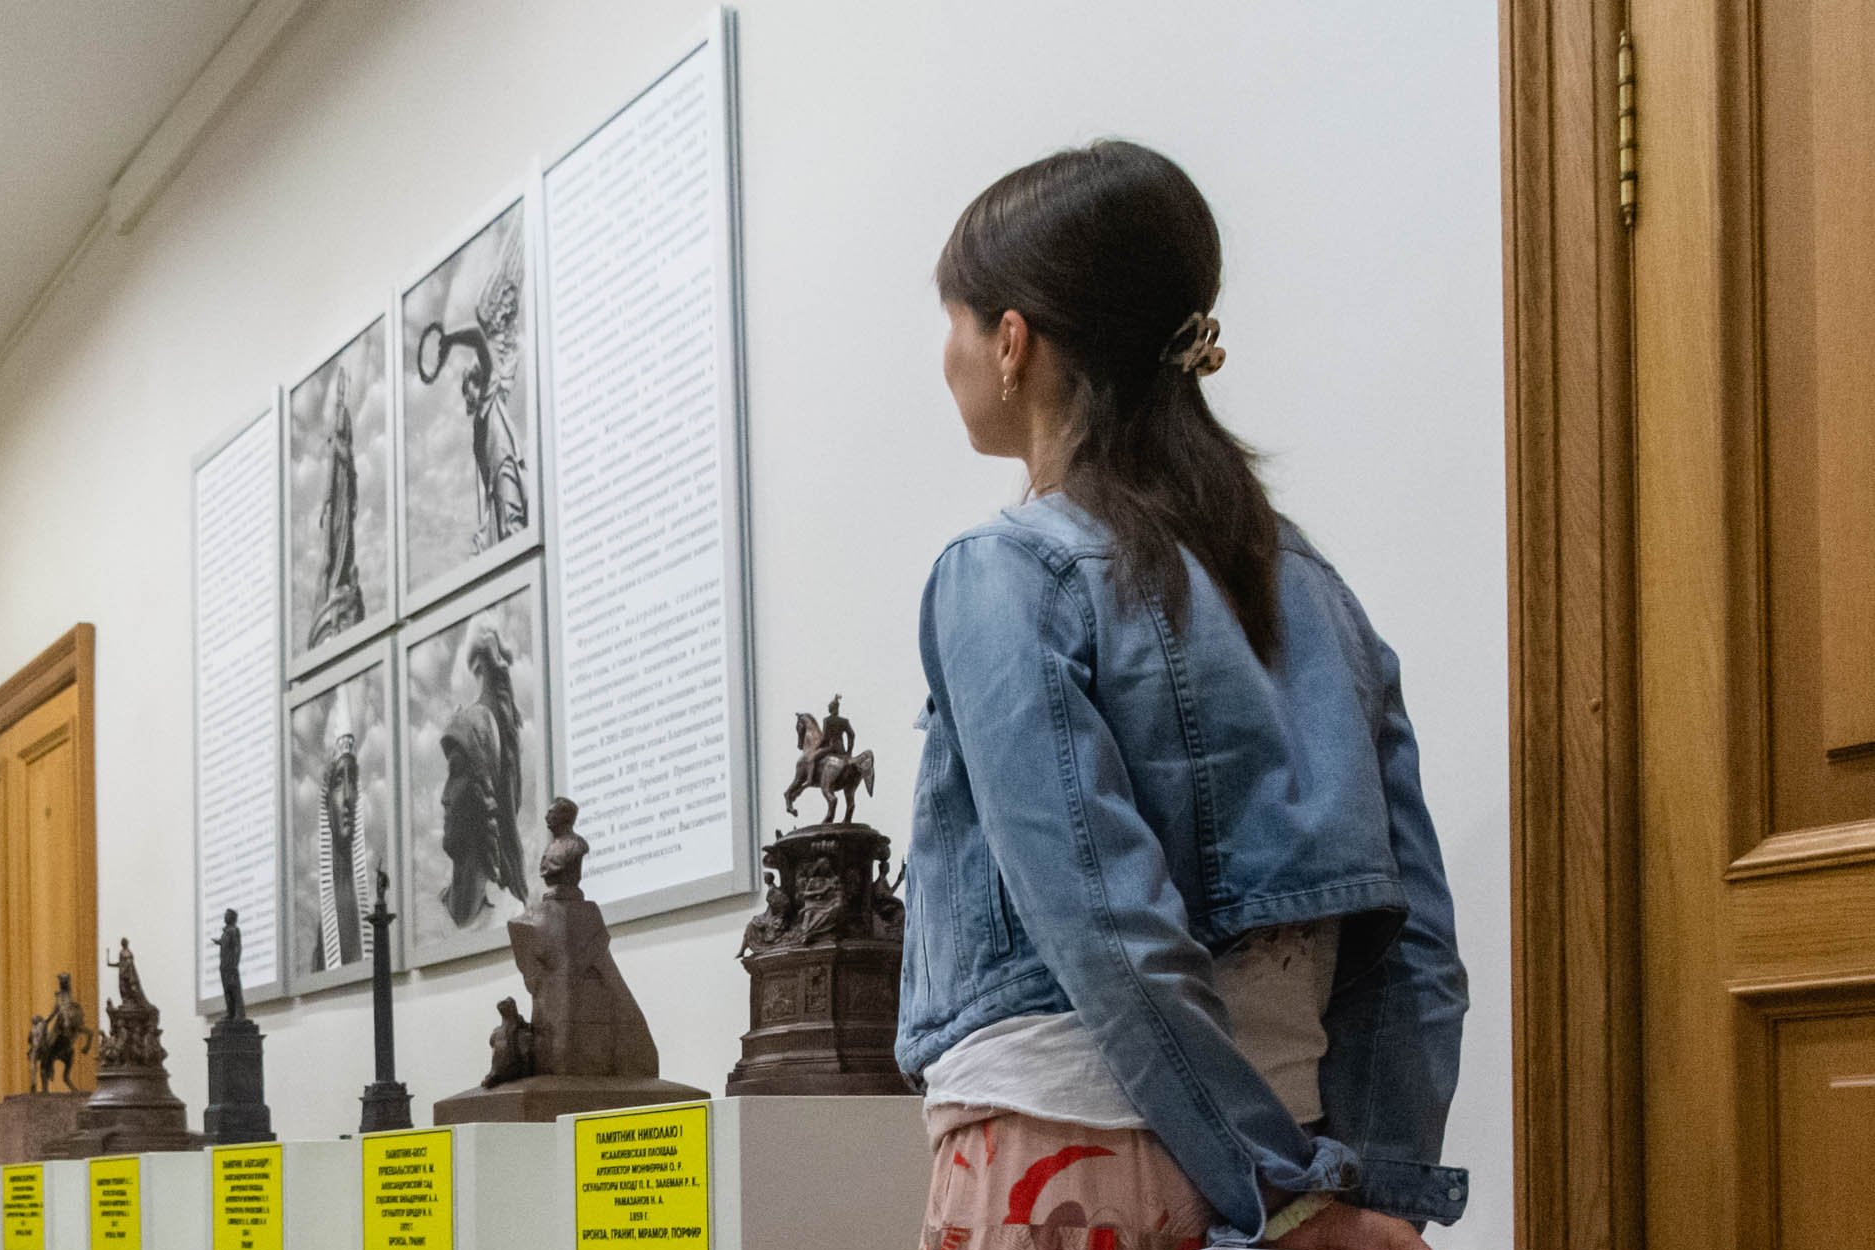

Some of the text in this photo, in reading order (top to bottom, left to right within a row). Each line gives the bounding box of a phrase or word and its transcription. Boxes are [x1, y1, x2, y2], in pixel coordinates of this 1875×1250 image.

[596, 1128, 636, 1145] ПАМЯТНИК
[637, 1126, 678, 1142] НИКОЛАЮ
[611, 1228, 637, 1240] ГРАНИТ,
[638, 1227, 670, 1240] МРАМОР,
[671, 1226, 702, 1239] ПОРФИР
